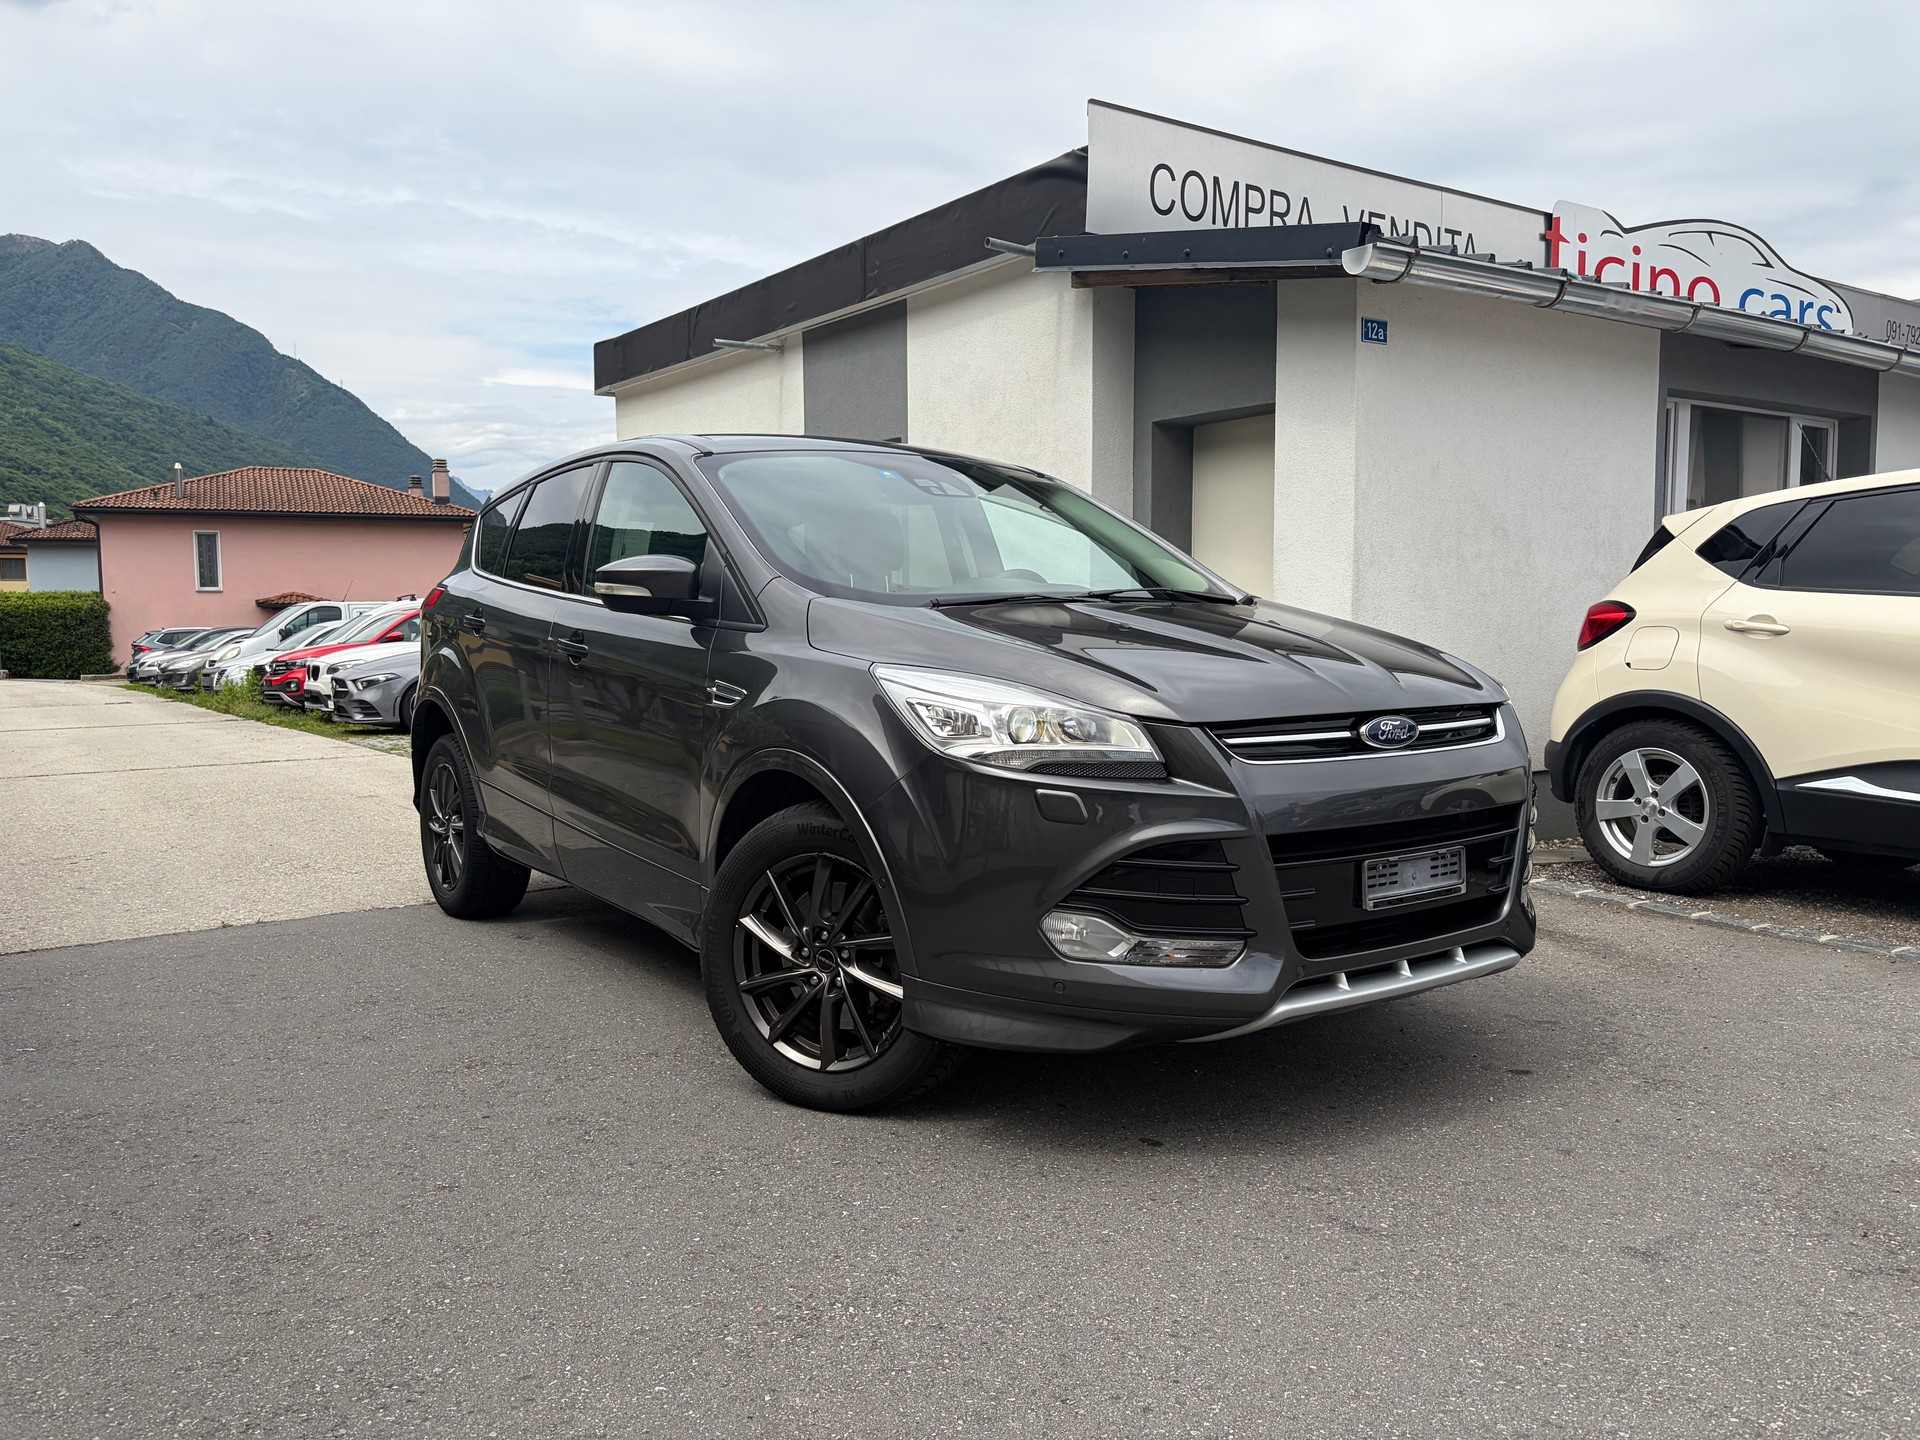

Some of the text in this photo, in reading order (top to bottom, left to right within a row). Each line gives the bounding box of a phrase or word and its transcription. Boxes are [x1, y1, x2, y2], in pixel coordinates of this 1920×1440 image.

[1150, 163, 1313, 228] COMPRA
[1546, 216, 1833, 330] ticino cars
[1367, 322, 1385, 340] 12a
[1378, 720, 1410, 740] Ford
[796, 821, 859, 847] WinterCo
